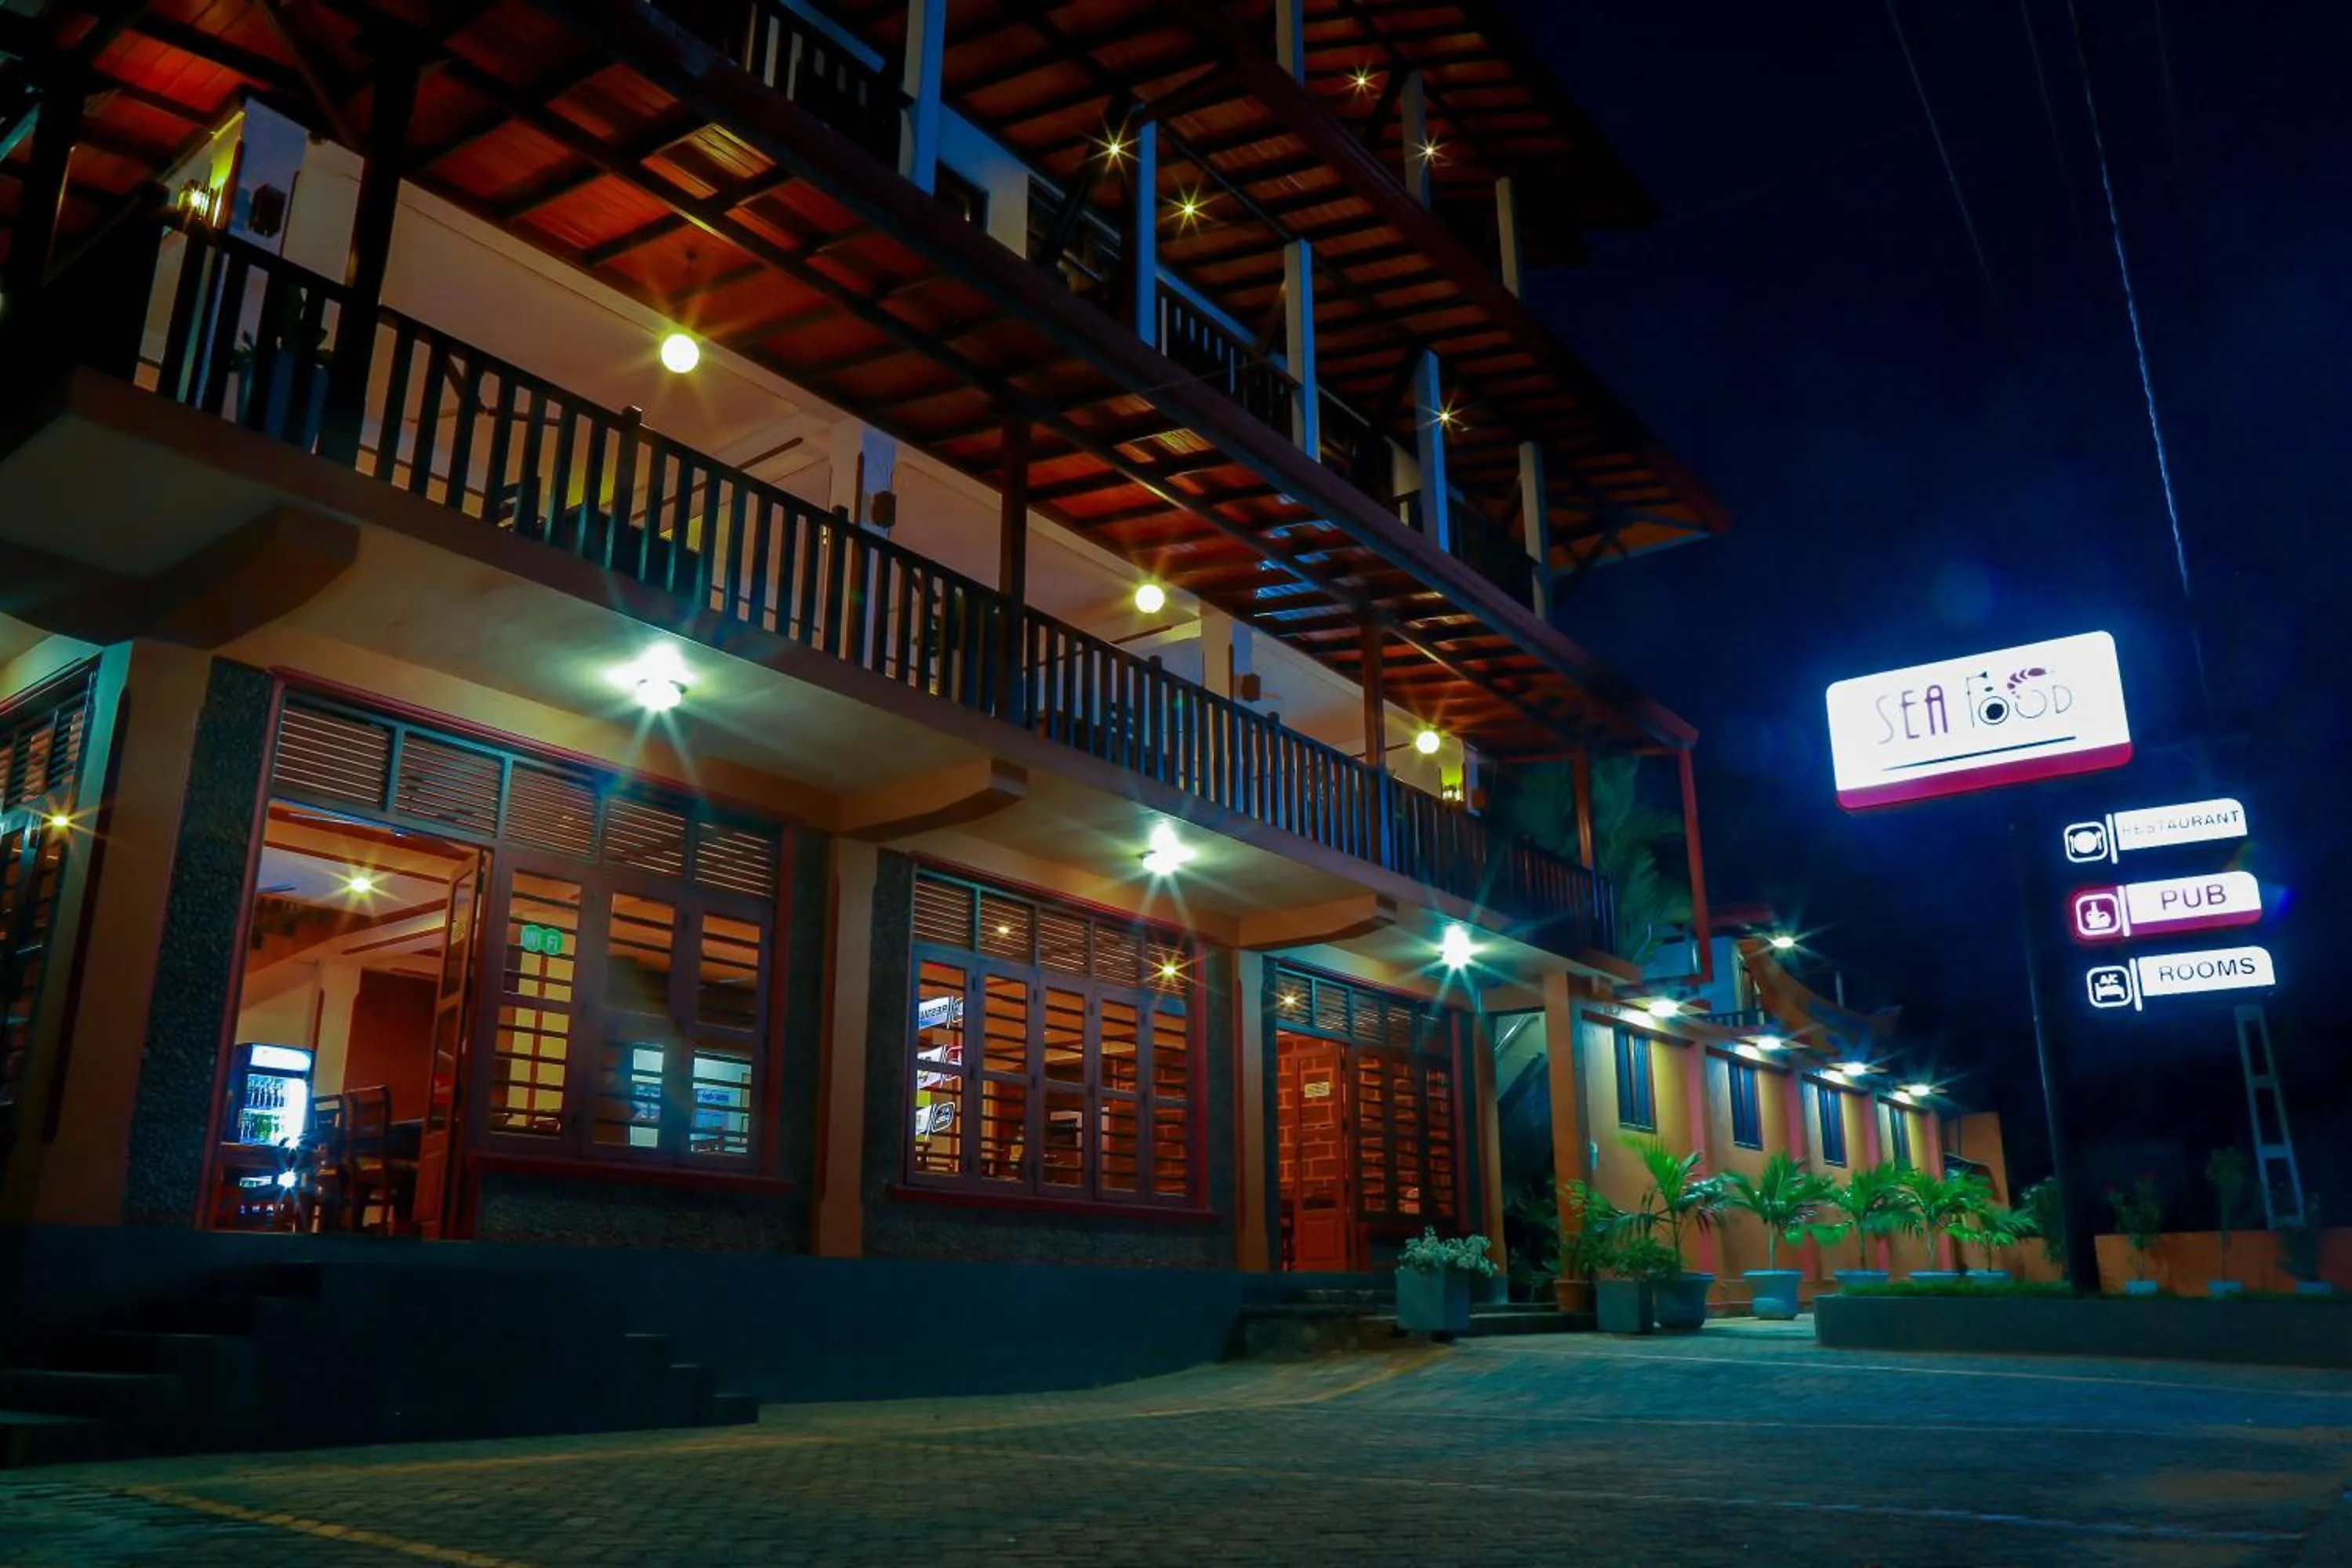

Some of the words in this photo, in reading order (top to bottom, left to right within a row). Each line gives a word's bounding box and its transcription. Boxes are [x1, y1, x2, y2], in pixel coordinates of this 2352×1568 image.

[1875, 684, 1949, 745] SEA
[1965, 667, 2074, 728] FOOD
[2122, 810, 2239, 835] RESTAURANT
[2161, 884, 2227, 910] PUB
[2158, 957, 2256, 982] ROOMS
